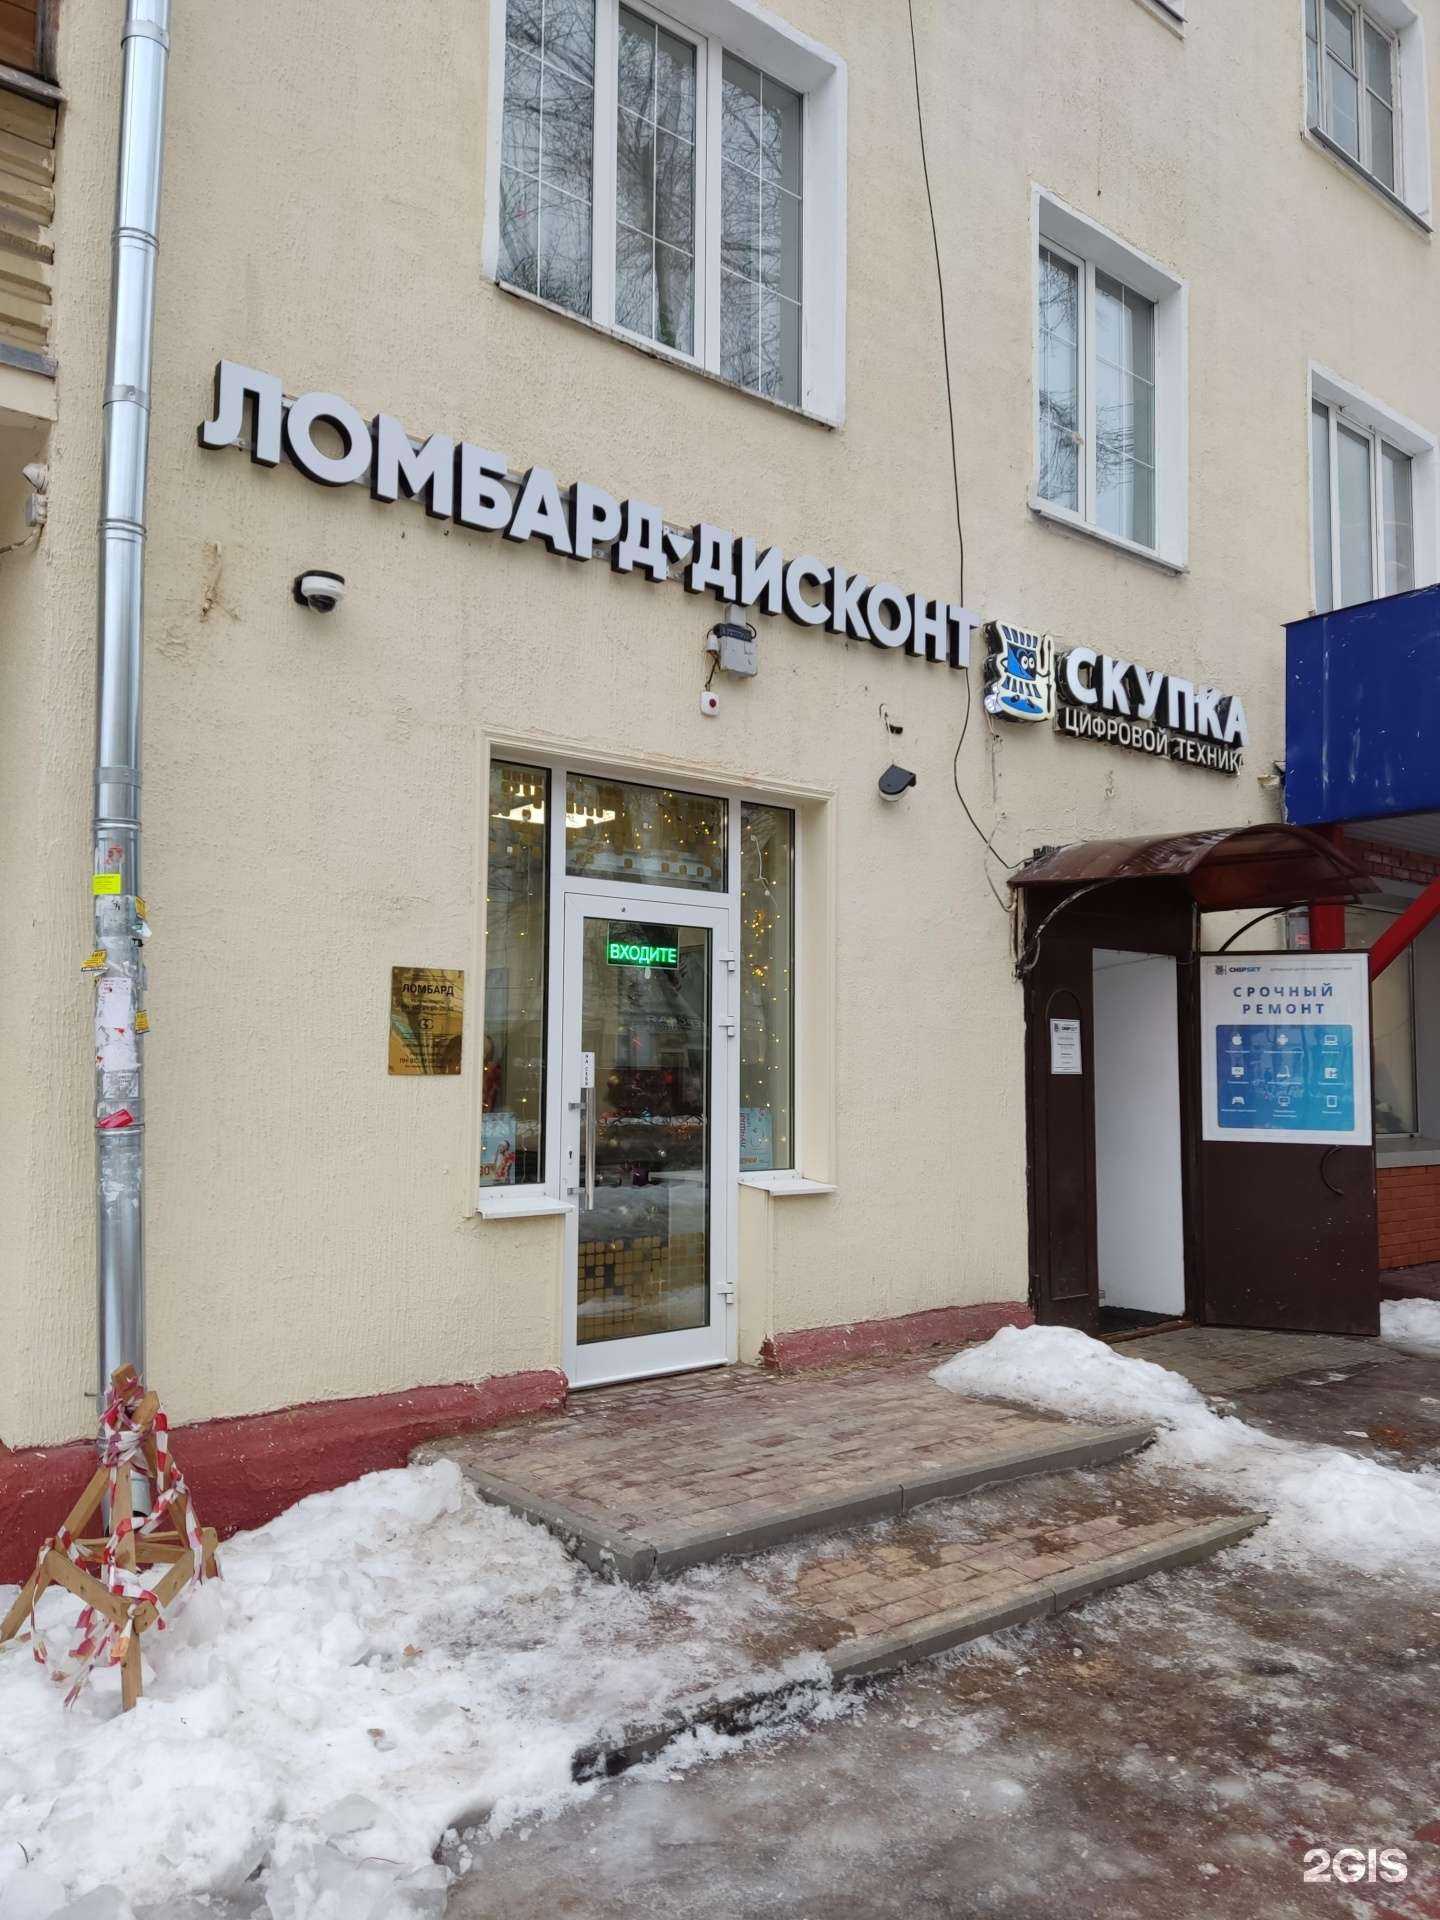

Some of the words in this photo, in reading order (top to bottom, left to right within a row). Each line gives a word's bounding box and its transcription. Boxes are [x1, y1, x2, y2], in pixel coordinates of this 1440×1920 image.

[200, 359, 668, 582] ЛОМБАРД
[688, 522, 981, 668] ДИСКОНТ
[1062, 647, 1249, 746] СКУПКА
[1065, 707, 1169, 755] ЦИФРОВОЙ
[610, 943, 677, 964] ВХОДИТЕ
[402, 983, 454, 997] ЛОМБАРД
[1233, 982, 1333, 998] СРОЧНЫЙ
[1242, 1003, 1325, 1014] РЕМОНТ
